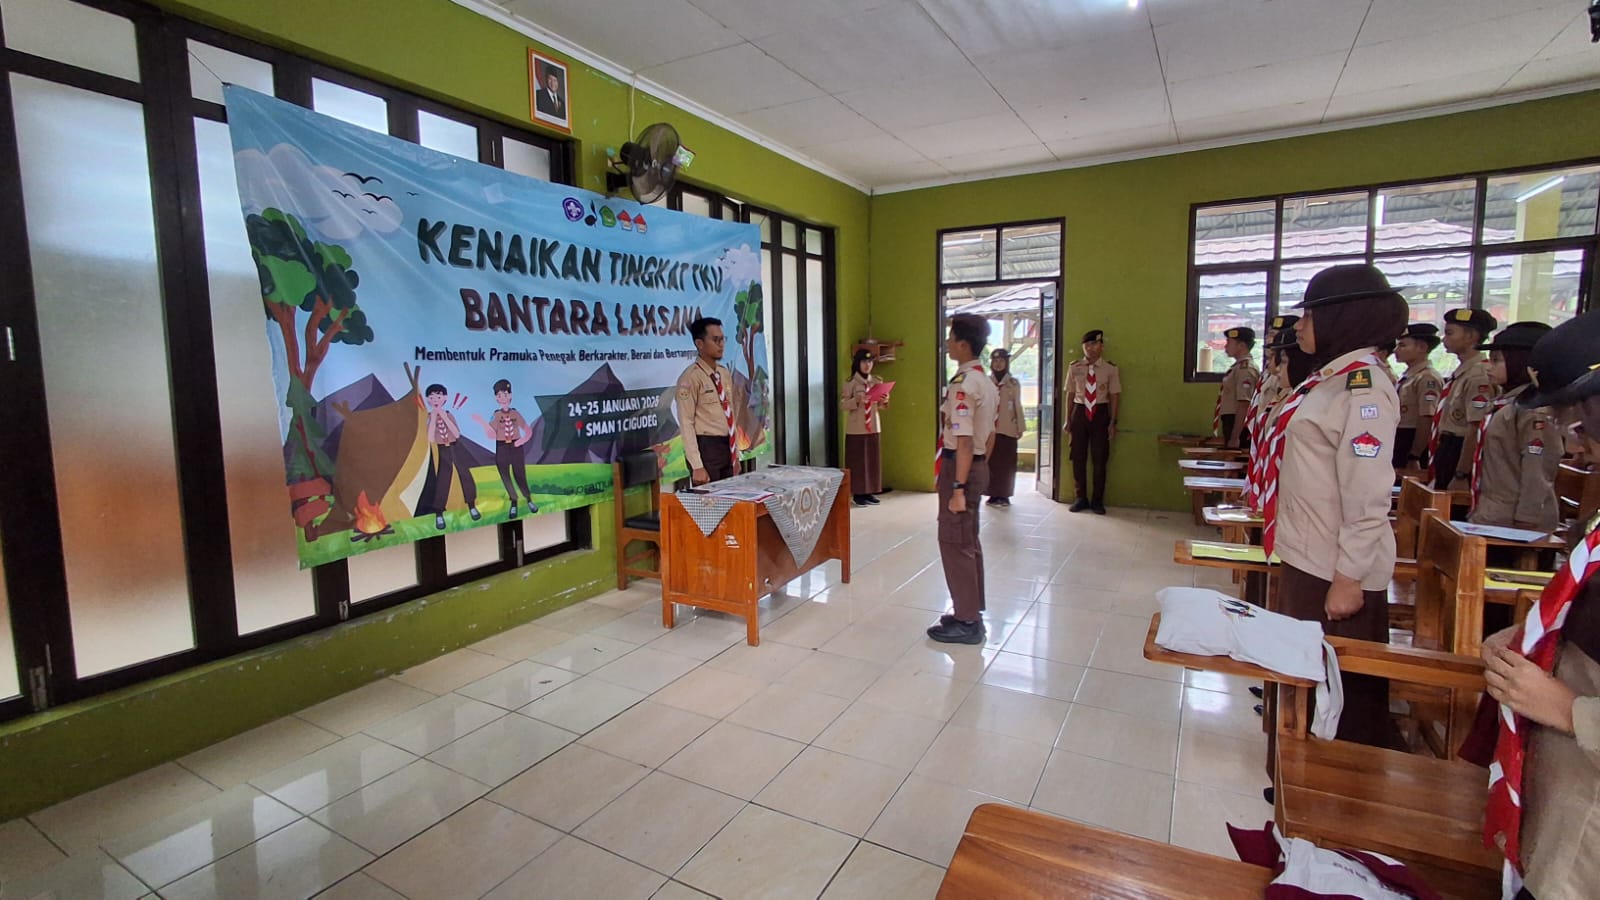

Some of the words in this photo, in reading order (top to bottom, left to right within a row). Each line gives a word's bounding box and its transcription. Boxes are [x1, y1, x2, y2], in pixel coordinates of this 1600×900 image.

[417, 217, 601, 283] KENAIKAN
[609, 251, 689, 292] TINGKAT
[692, 263, 723, 293] TKU
[459, 287, 611, 336] BANTARA
[415, 346, 485, 361] Membentuk
[490, 347, 538, 361] Pramuka
[539, 348, 576, 364] Penegak
[579, 348, 629, 362] Berkarakter,
[631, 348, 652, 360] Berani
[653, 348, 665, 360] dan
[568, 401, 599, 417] 24-25
[601, 396, 640, 413] JANUARI
[585, 420, 615, 437] SMAN
[617, 419, 621, 432] 1
[622, 413, 657, 431] CIGUDEG
